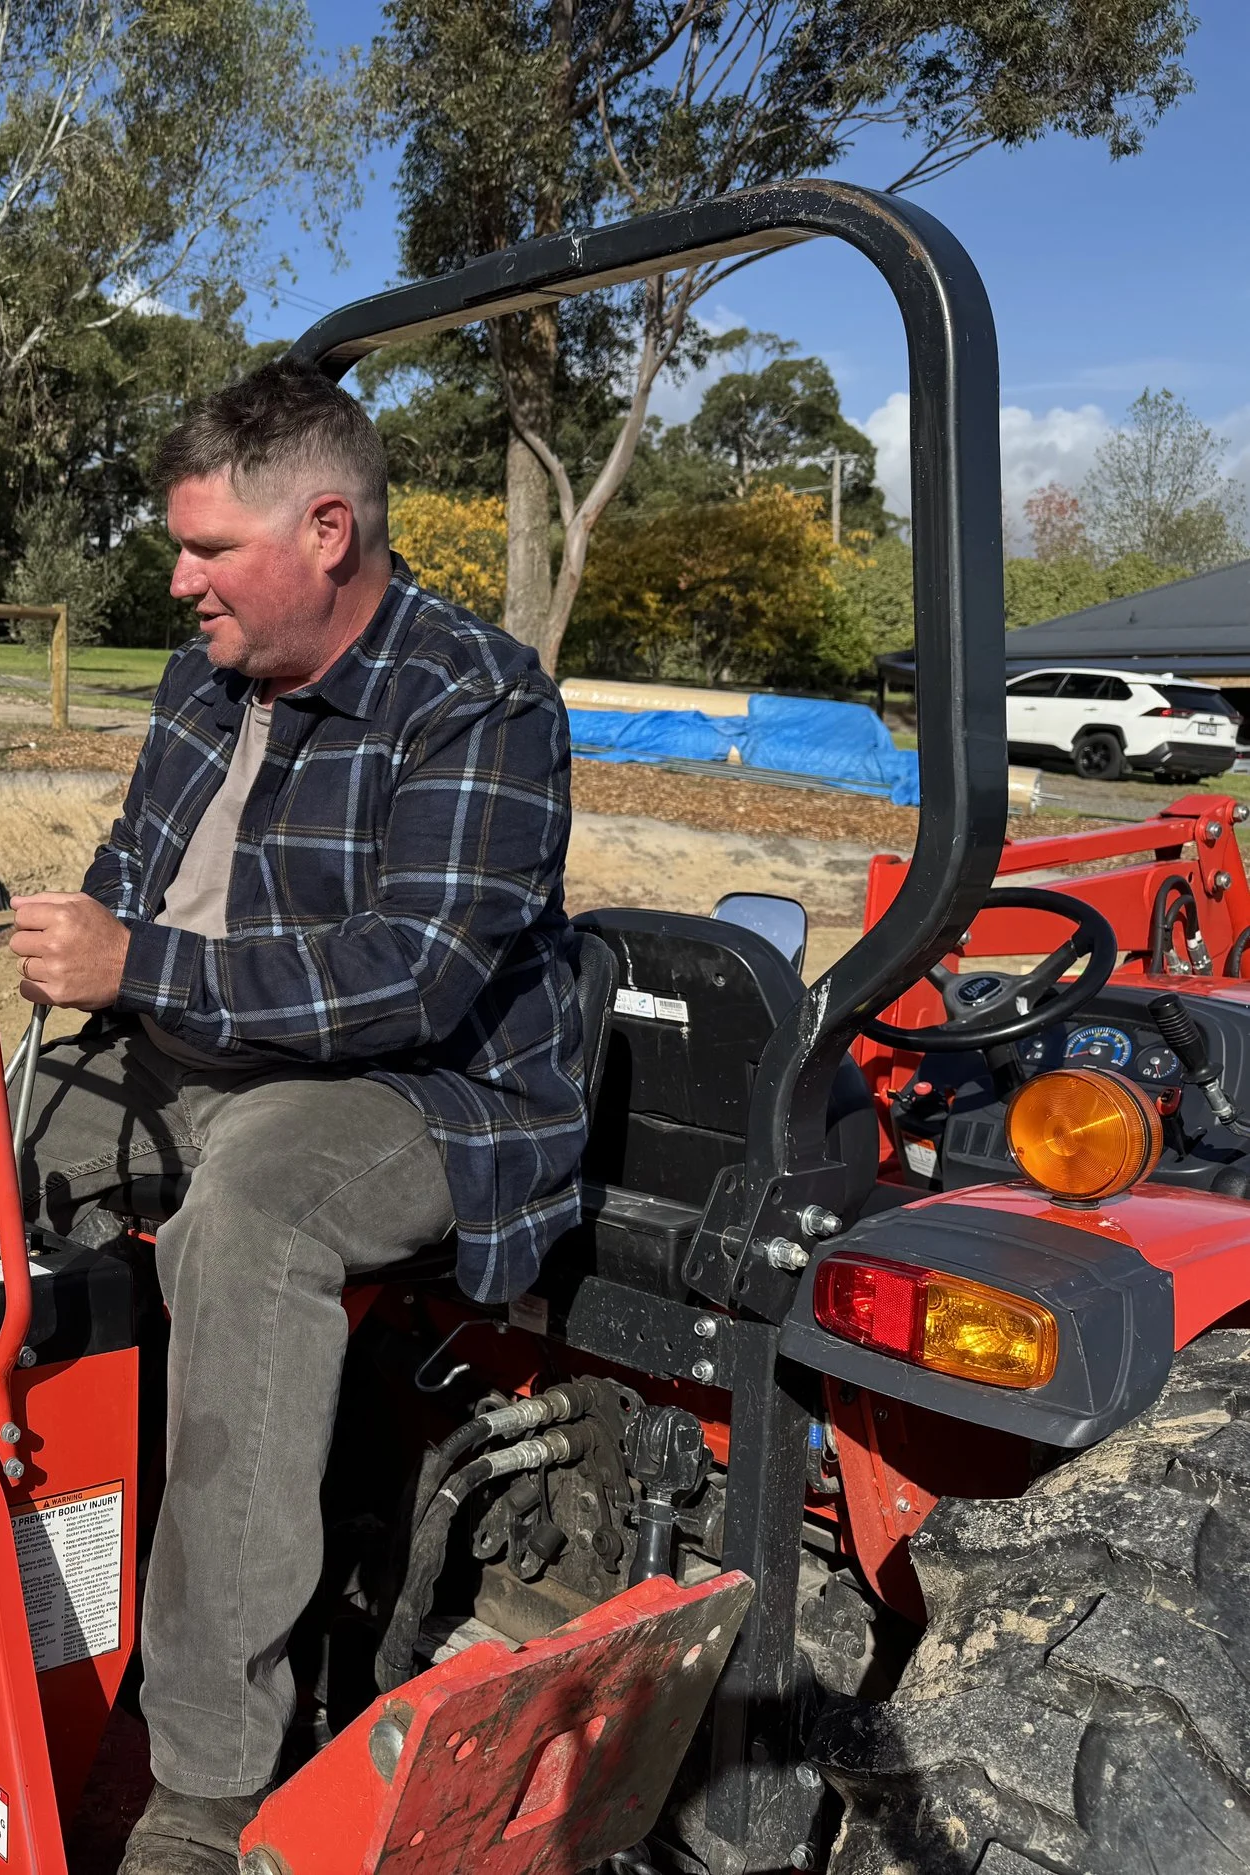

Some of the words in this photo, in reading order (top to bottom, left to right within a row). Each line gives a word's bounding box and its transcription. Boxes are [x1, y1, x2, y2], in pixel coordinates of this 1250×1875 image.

[51, 1493, 83, 1505] WARNING
[18, 1511, 56, 1527] PREVENT
[58, 1503, 88, 1516] BODILY
[89, 1496, 118, 1509] INJURY
